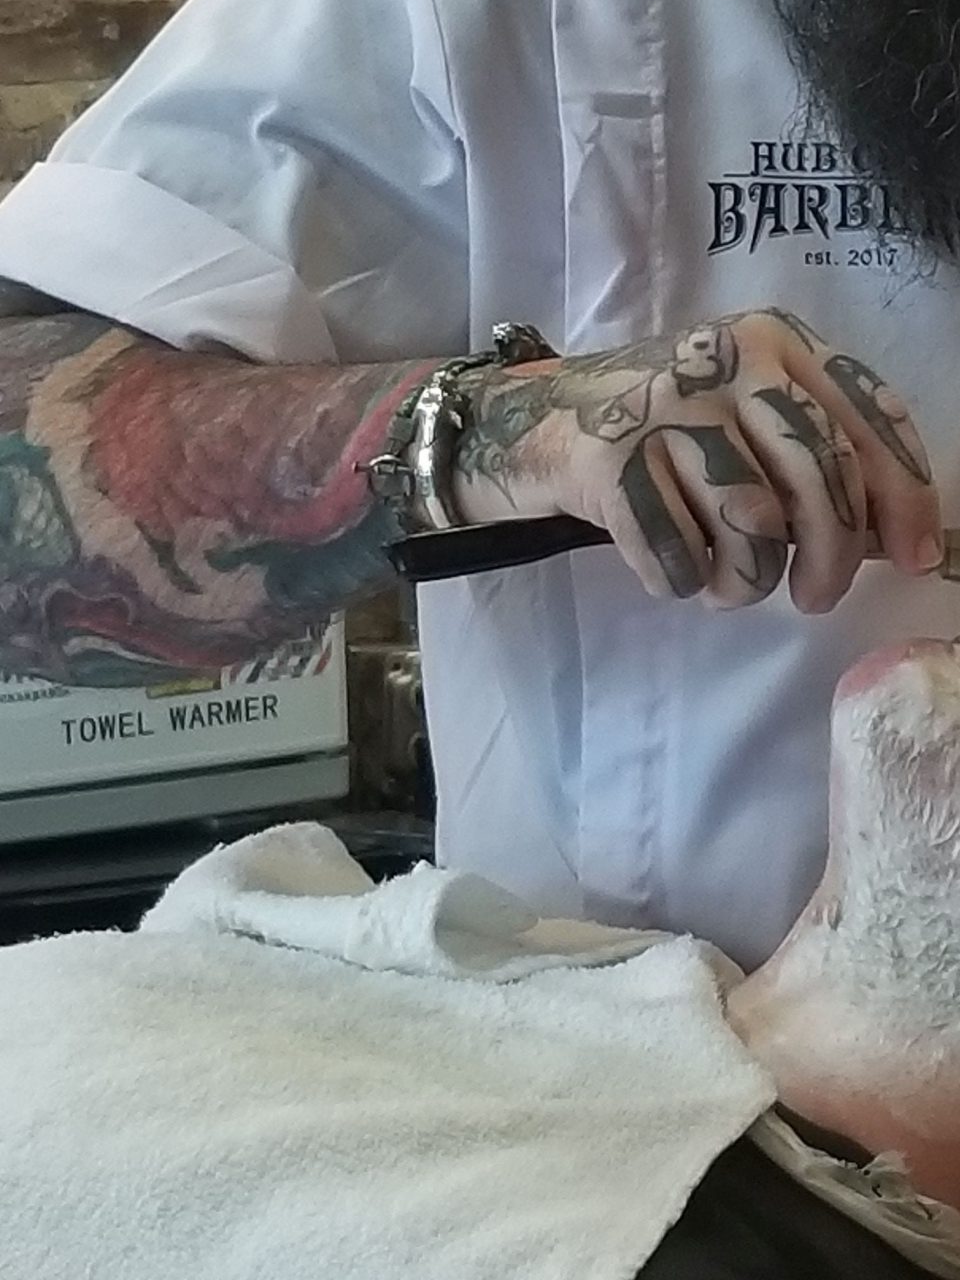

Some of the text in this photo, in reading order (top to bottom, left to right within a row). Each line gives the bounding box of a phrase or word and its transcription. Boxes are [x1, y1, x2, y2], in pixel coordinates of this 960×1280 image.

[751, 141, 835, 176] HUB
[848, 248, 898, 266] 2017
[61, 694, 279, 745] TOWEL WARMER
